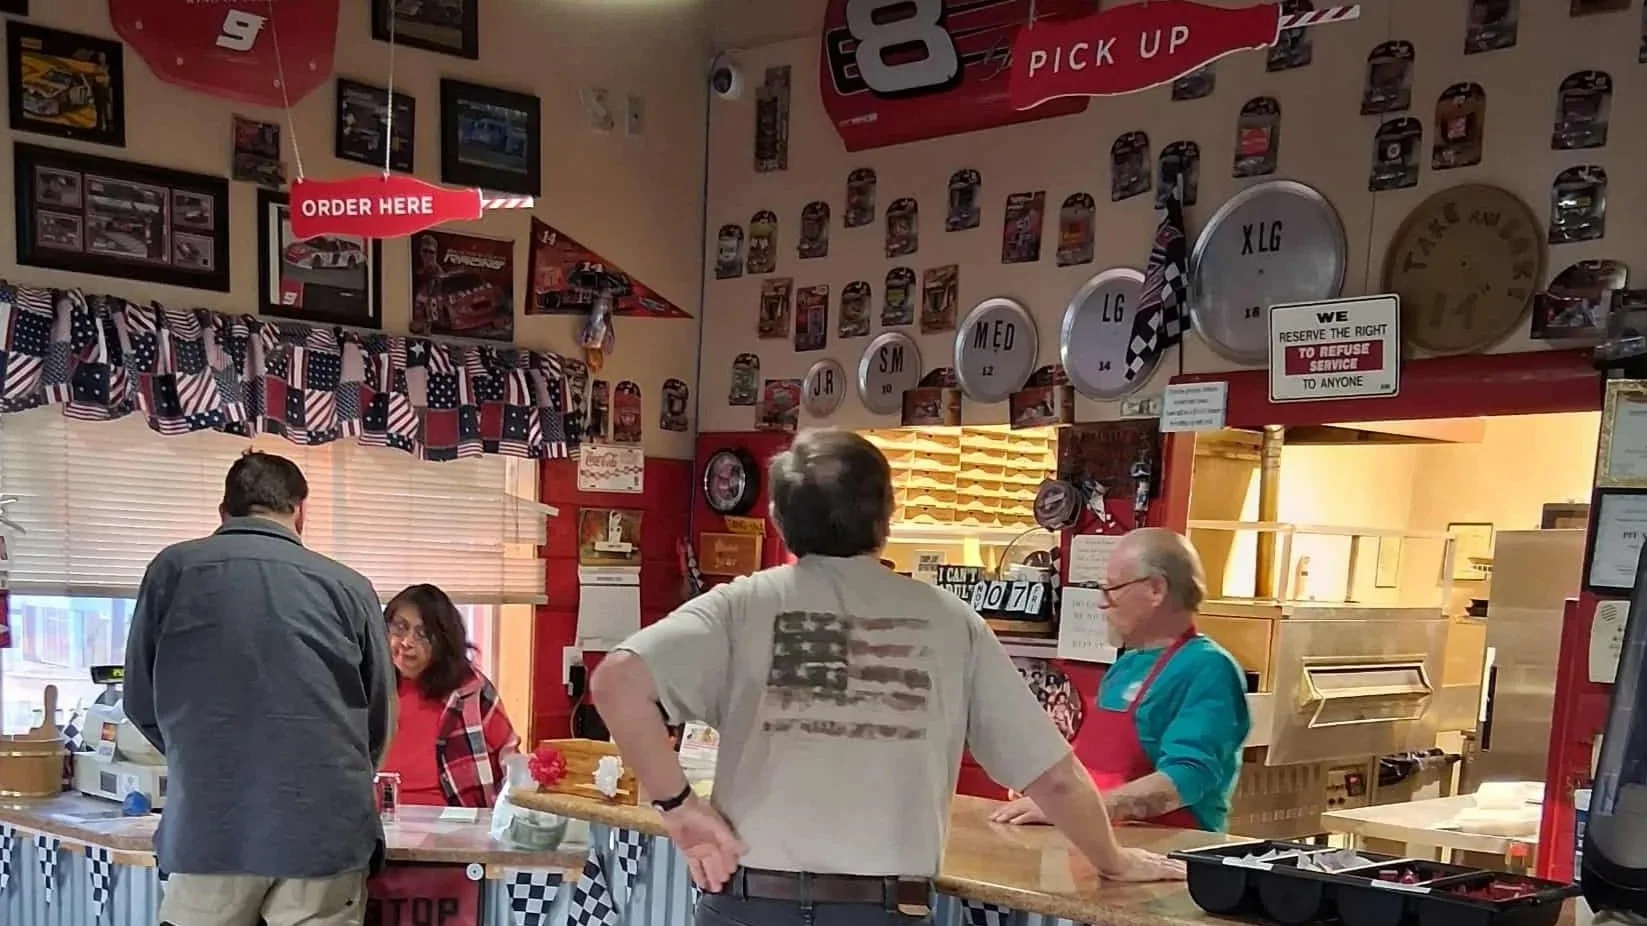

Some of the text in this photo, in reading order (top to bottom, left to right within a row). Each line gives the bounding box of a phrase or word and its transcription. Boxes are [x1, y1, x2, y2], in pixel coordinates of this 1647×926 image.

[216, 8, 267, 51] 9
[1029, 37, 1117, 78] PICK
[1139, 25, 1189, 59] UP
[301, 196, 433, 216] ORDER HERE
[542, 230, 557, 246] 14
[1241, 220, 1282, 256] XLG
[1403, 202, 1460, 273] TAKE
[1102, 293, 1125, 323] LG
[1316, 310, 1349, 323] WE
[973, 319, 1016, 352] MED
[1279, 323, 1387, 343] RESERVE THE RIGHT
[879, 345, 905, 374] SM
[1298, 342, 1371, 359] TO REFUSE
[1098, 360, 1112, 372] 14
[1309, 357, 1359, 373] SERVICE
[813, 369, 834, 397] JR
[1303, 375, 1364, 390] TO ANYONE
[938, 567, 944, 583] I
